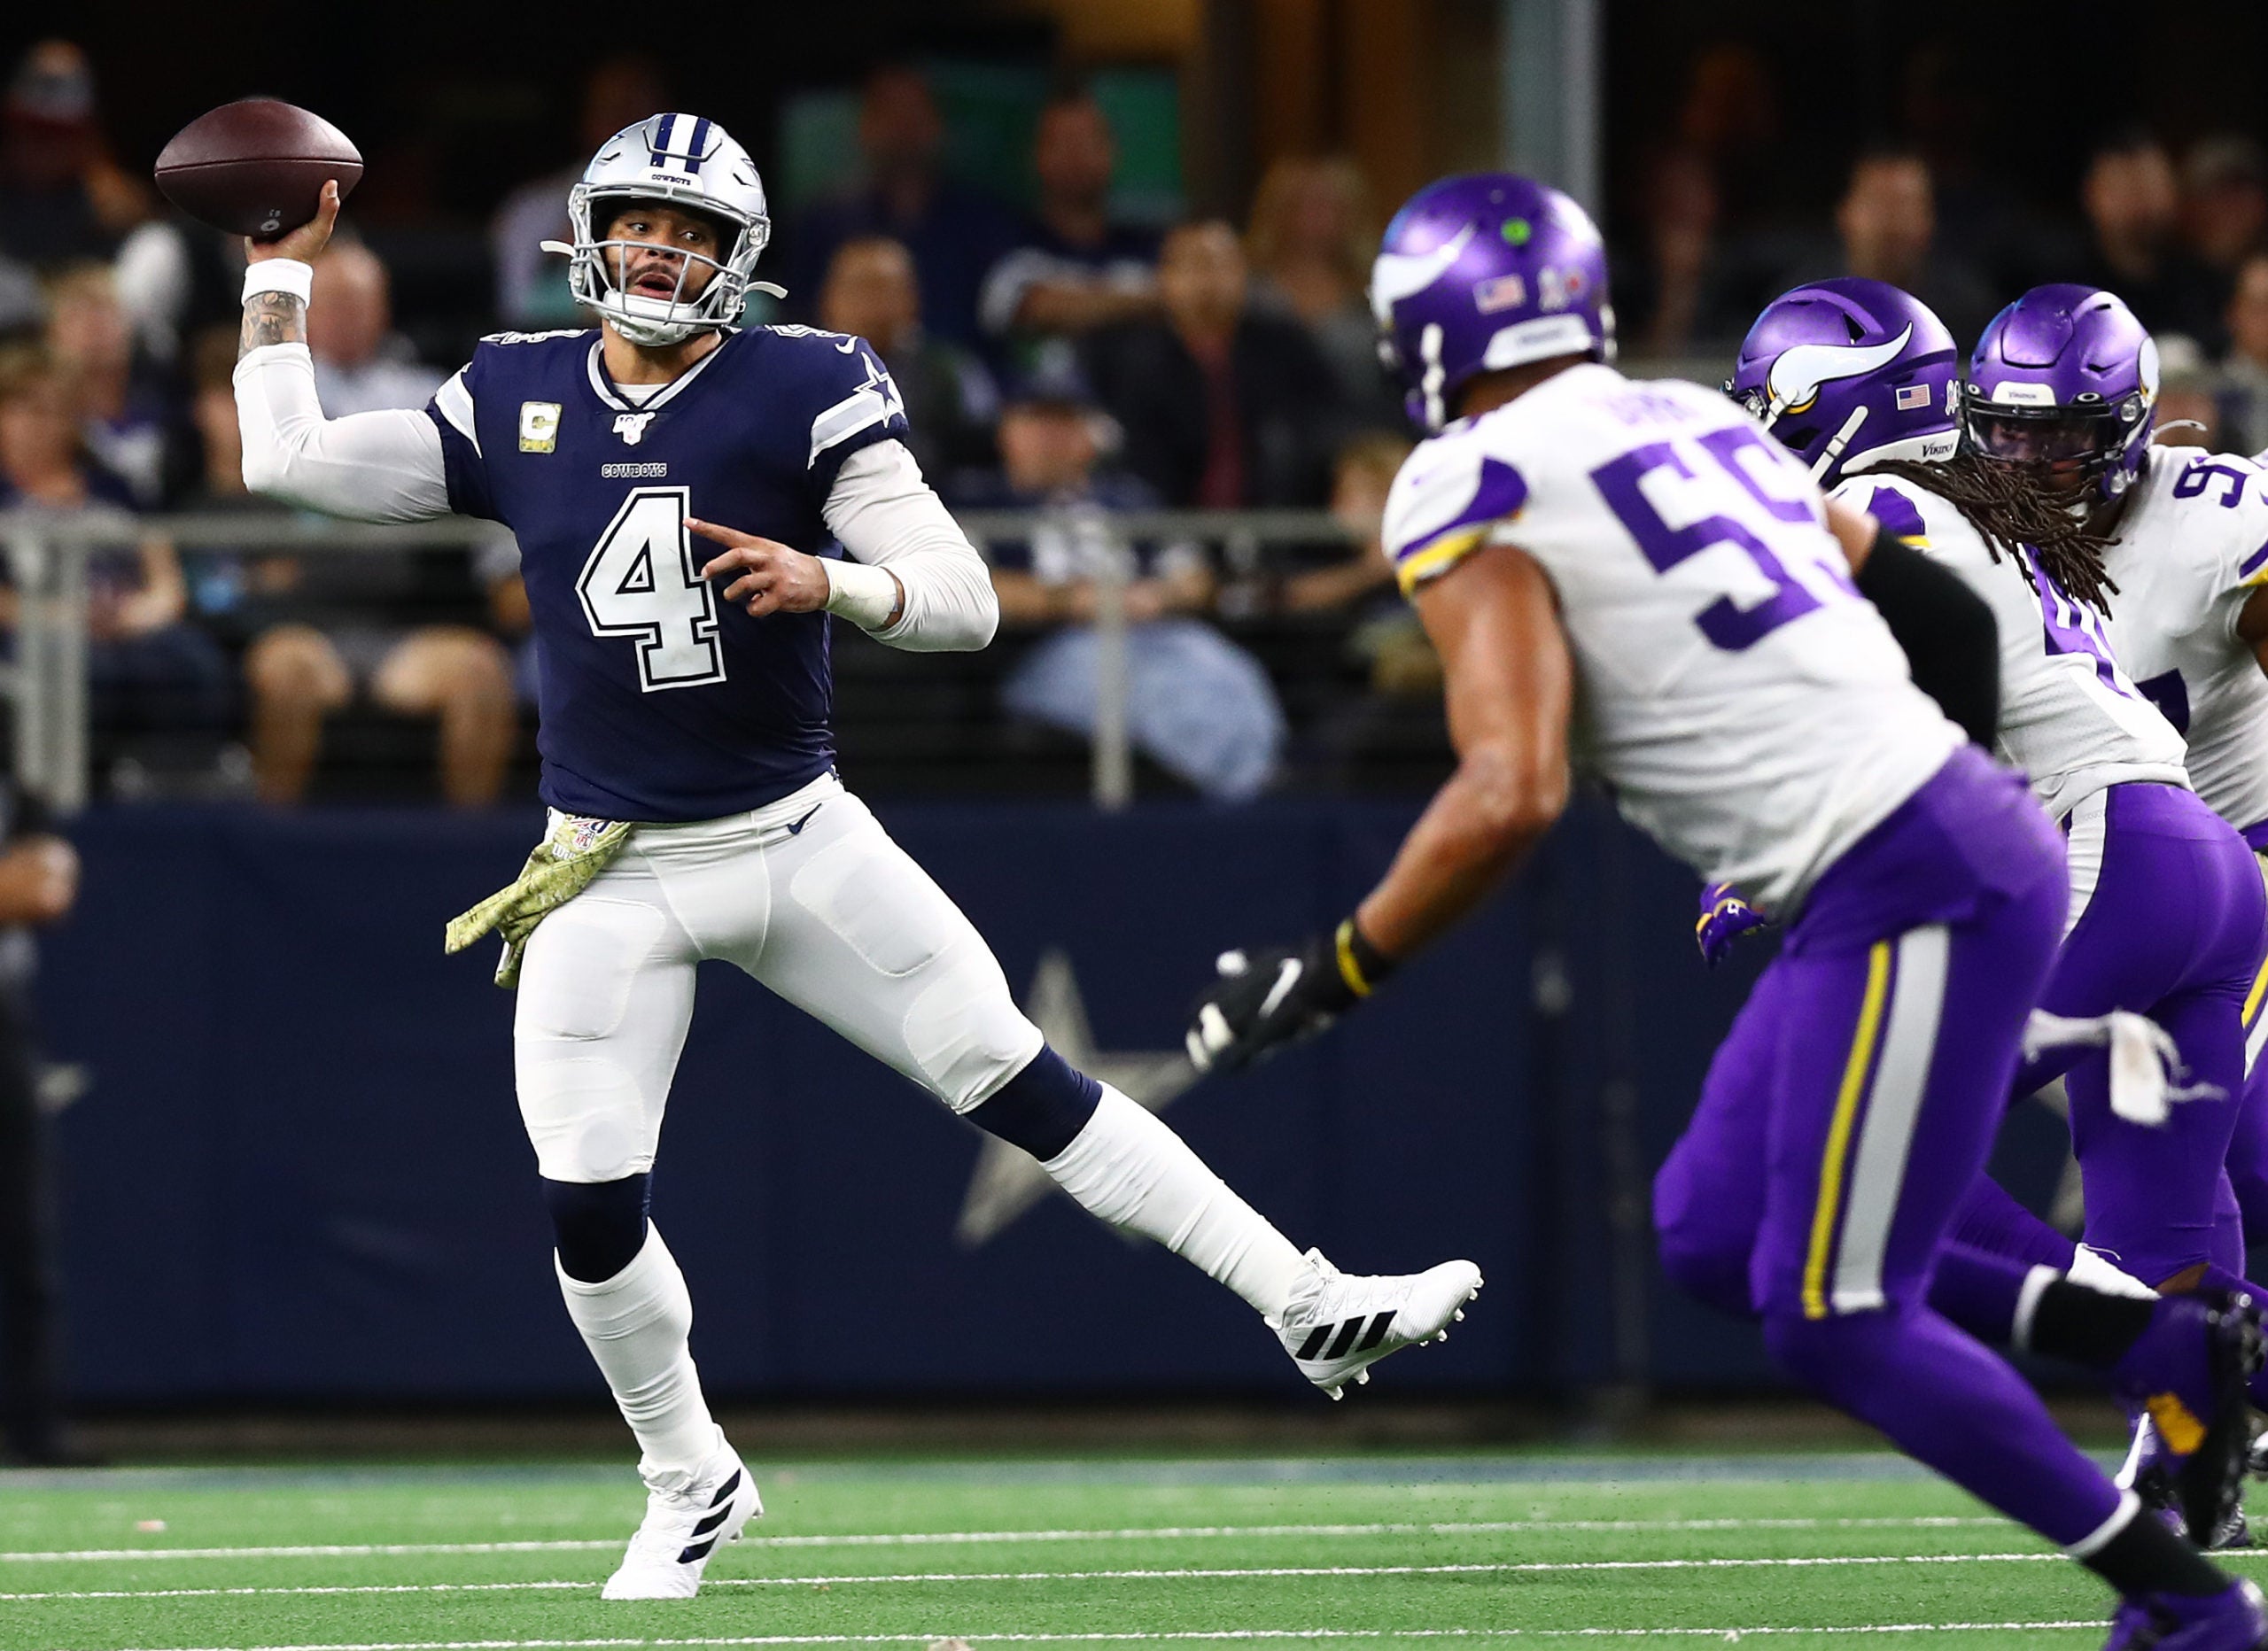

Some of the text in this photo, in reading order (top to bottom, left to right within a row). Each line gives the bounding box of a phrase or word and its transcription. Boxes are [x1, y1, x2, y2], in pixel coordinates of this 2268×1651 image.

[651, 174, 691, 186] COWBOYS
[522, 404, 558, 441] C
[602, 463, 667, 478] COWBOYS
[2172, 456, 2249, 509] 9
[575, 485, 727, 693] 4
